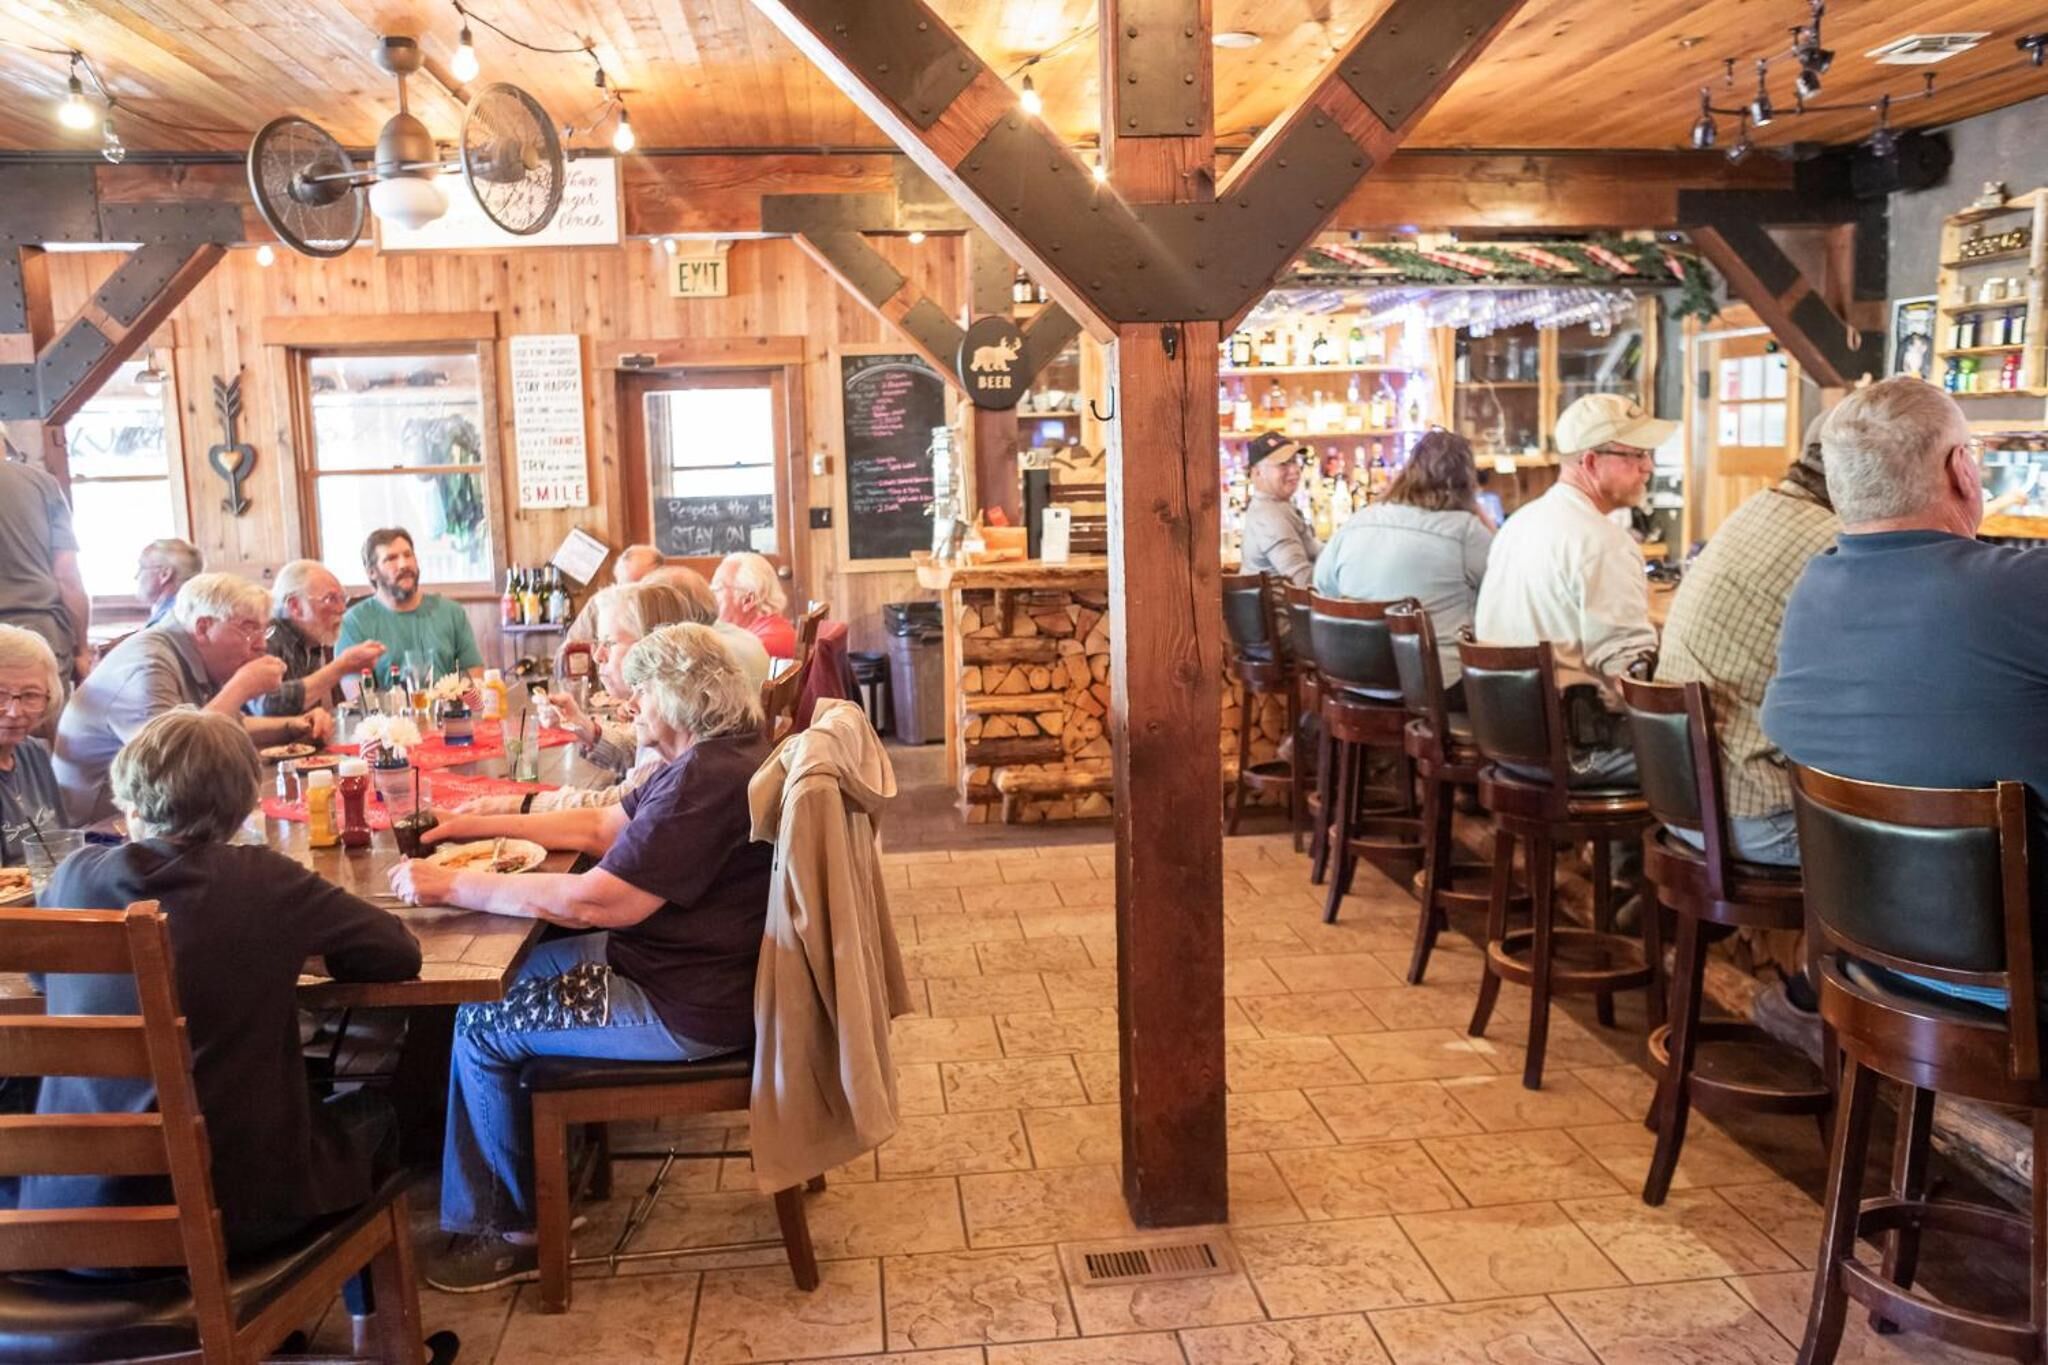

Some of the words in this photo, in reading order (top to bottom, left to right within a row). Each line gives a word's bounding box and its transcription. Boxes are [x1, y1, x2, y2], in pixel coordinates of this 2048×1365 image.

[678, 261, 720, 293] EXIT
[516, 381, 540, 394] STAY
[544, 380, 578, 393] HAPPY
[977, 375, 1012, 389] BEER
[523, 483, 585, 503] SMILE
[726, 523, 745, 545] ON
